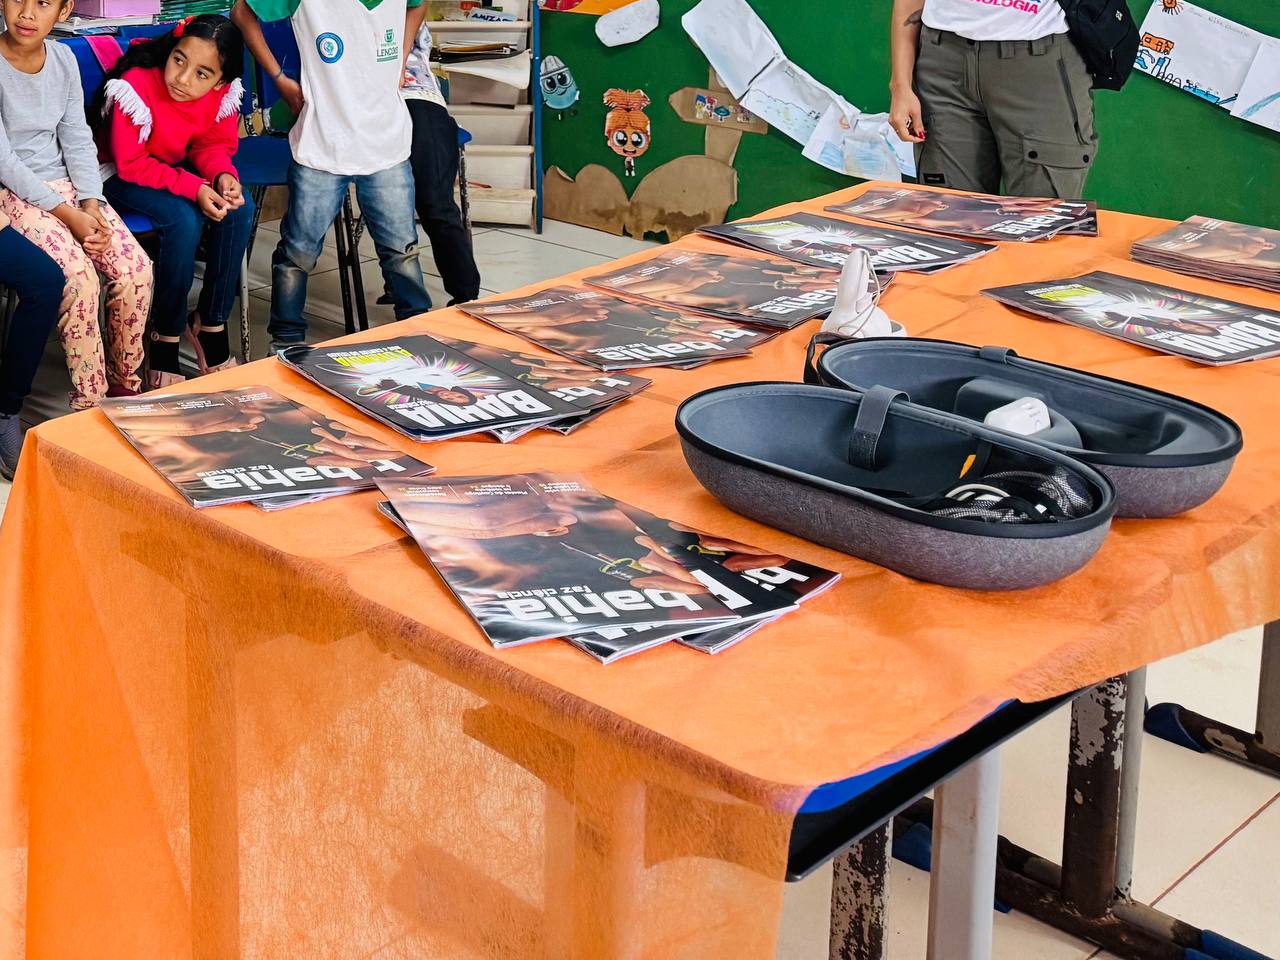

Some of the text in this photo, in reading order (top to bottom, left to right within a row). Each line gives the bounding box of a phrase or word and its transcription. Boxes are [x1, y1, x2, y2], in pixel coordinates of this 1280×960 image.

[595, 340, 727, 362] bahia
[395, 389, 553, 428] BAHIA
[203, 465, 363, 491] bahia
[560, 584, 591, 595] faz
[504, 587, 703, 623] bahia
